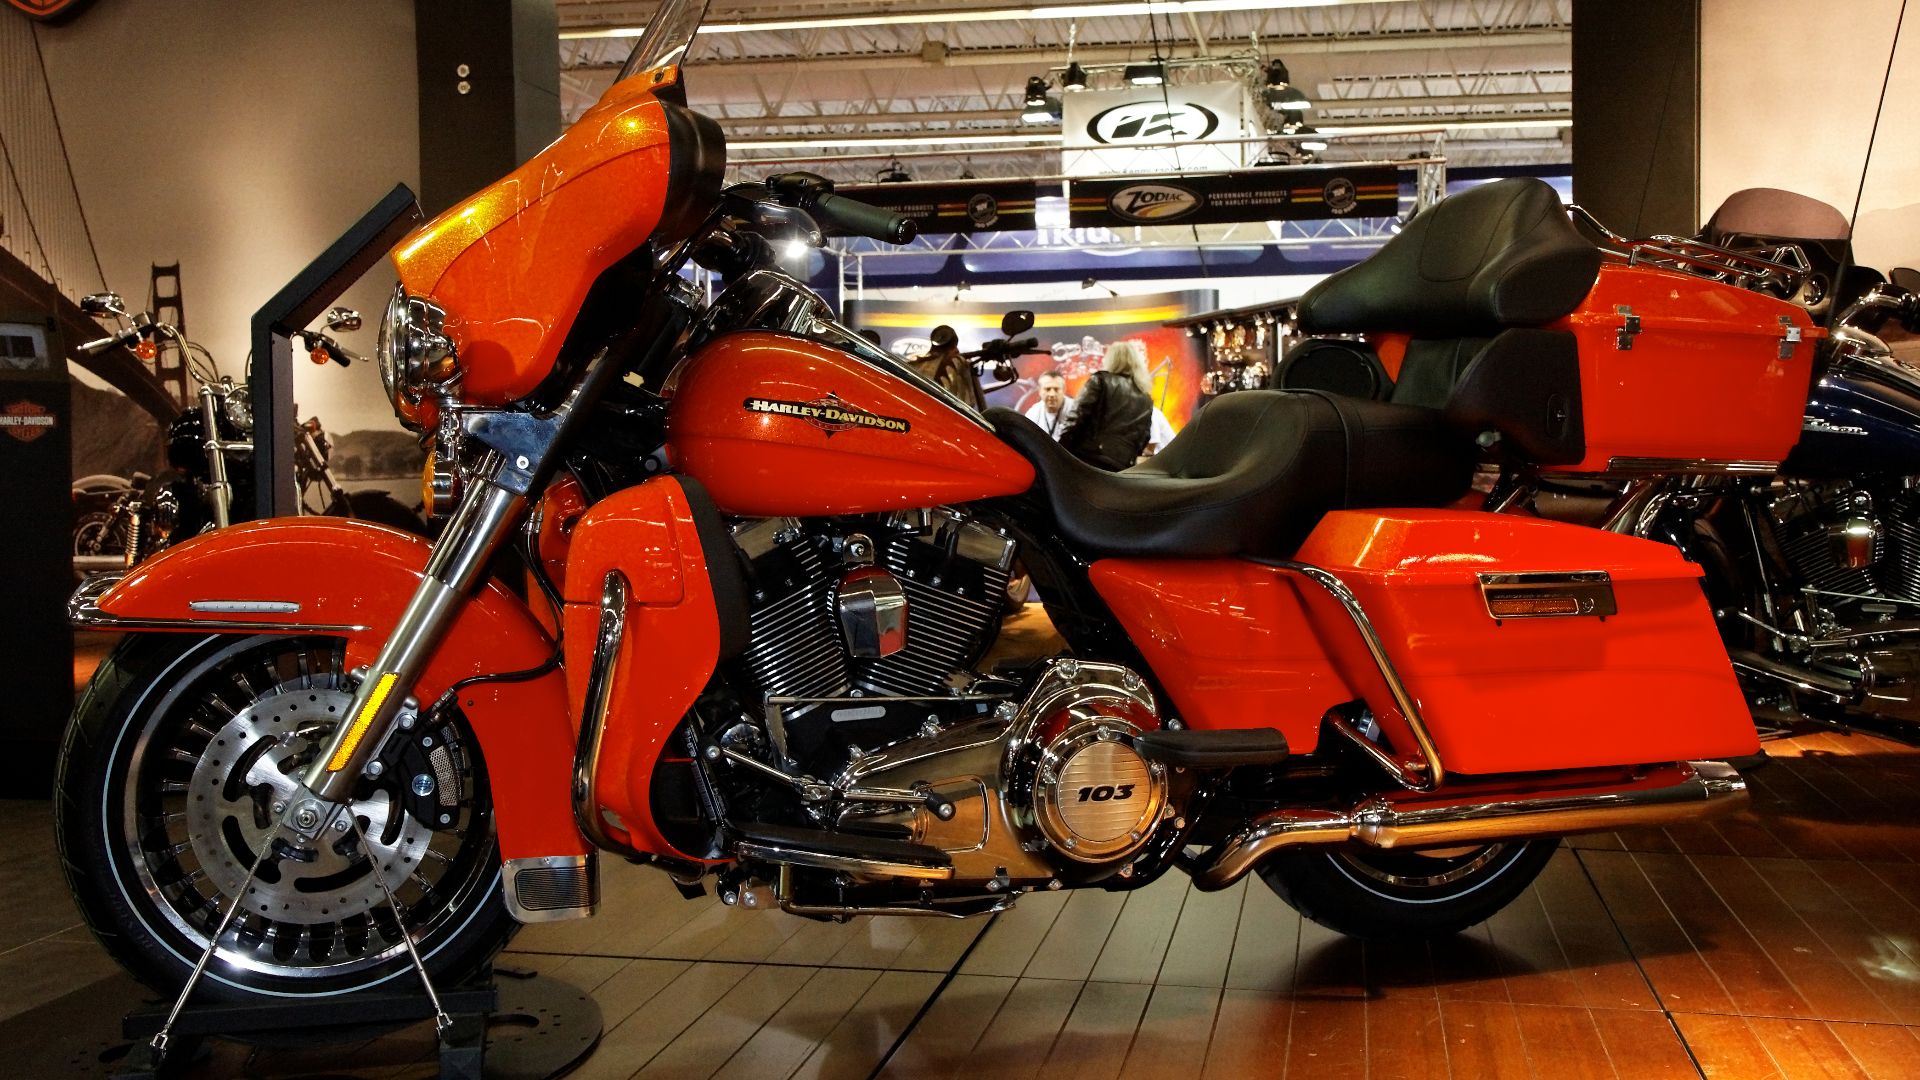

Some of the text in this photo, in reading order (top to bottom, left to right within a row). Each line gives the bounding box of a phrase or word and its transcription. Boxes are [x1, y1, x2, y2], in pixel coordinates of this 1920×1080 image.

[1126, 190, 1185, 214] ZODIAC
[1208, 190, 1288, 200] PERFORMANCE PRODUCTS
[750, 399, 906, 431] HARLEY-DAVIDSON
[1078, 784, 1135, 802] 103
